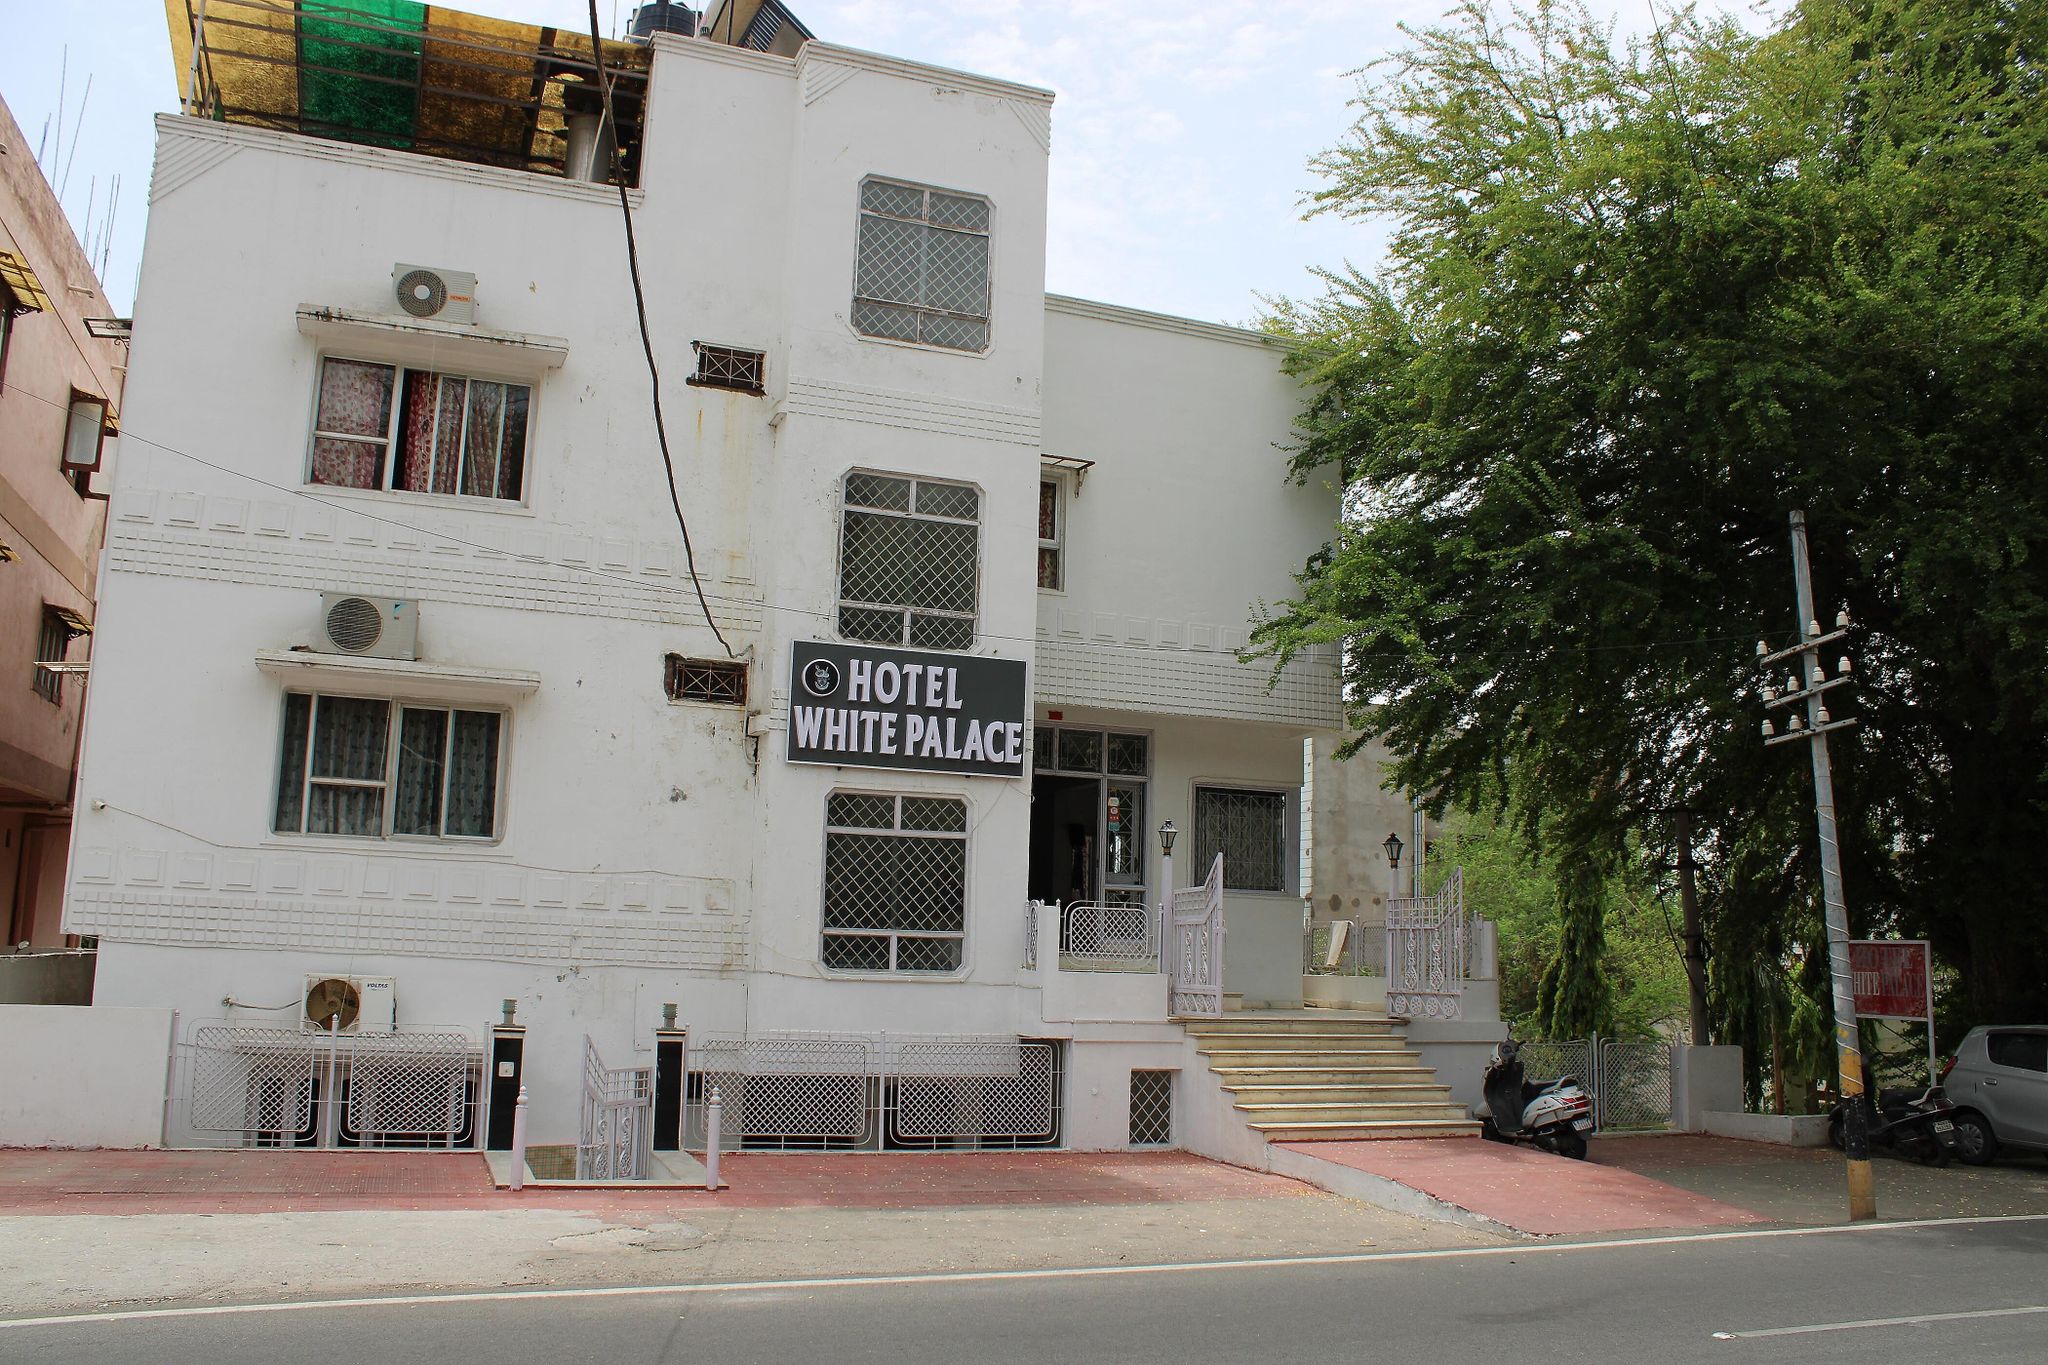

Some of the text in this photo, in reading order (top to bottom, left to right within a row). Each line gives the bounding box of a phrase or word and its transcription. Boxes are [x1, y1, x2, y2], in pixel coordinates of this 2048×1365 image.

[847, 658, 963, 710] HOTEL
[793, 705, 1023, 764] WHITE PALACE
[1853, 972, 1880, 995] HITE
